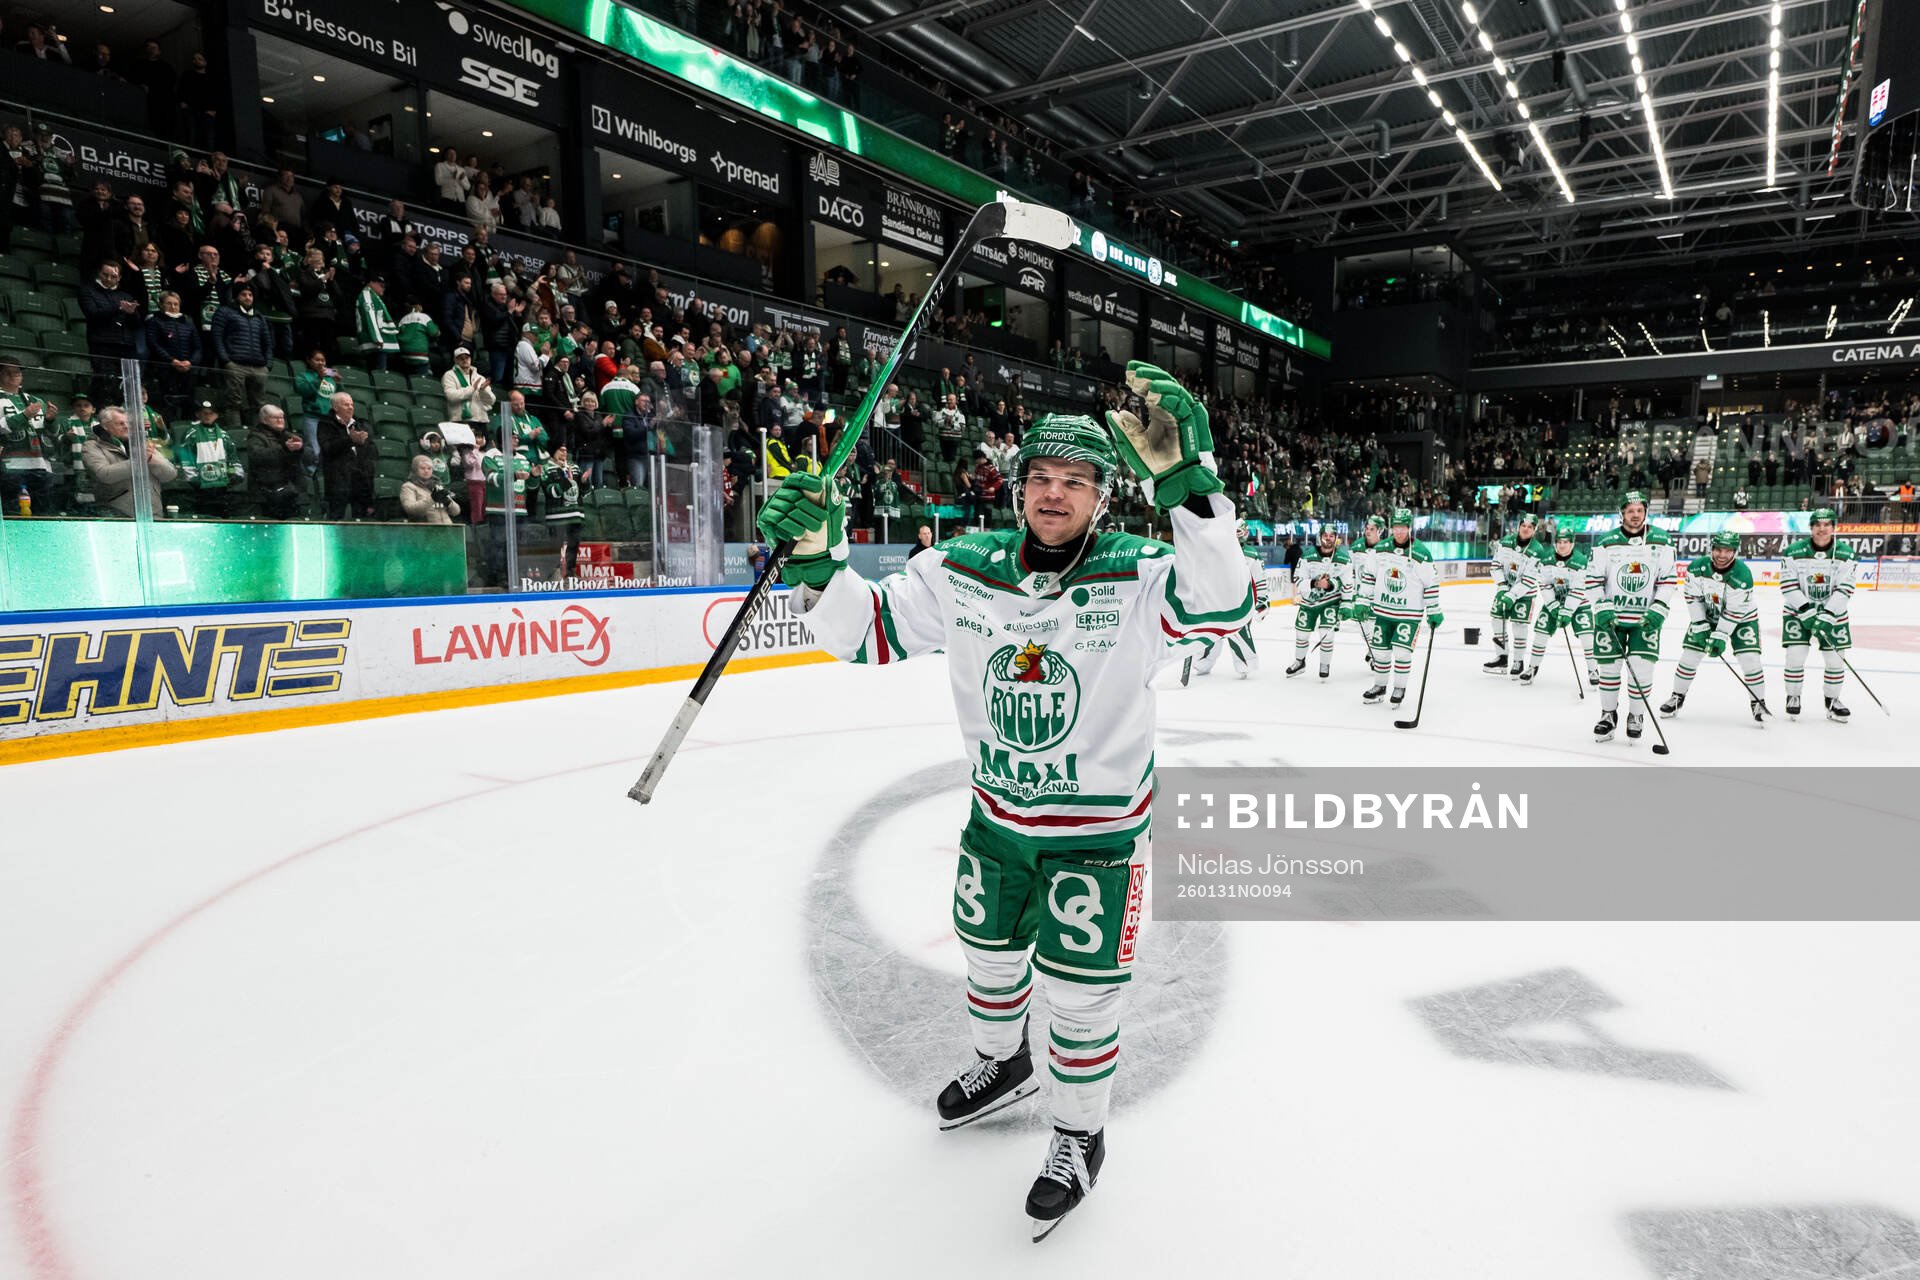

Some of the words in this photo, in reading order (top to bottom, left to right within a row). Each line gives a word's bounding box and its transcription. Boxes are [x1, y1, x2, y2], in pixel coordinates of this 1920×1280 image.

[393, 40, 417, 67] Bil
[473, 24, 559, 78] swedlog
[458, 57, 542, 107] SSE
[614, 115, 697, 163] Wihlborgs
[80, 145, 167, 179] BJÄRE
[82, 162, 168, 188] ENTREPRENAD
[727, 160, 779, 194] prenad
[819, 195, 864, 227] DACO
[1832, 345, 1904, 362] CATENA
[521, 577, 565, 592] Boozt
[568, 576, 610, 591] Boozt
[614, 575, 652, 589] Boozt
[658, 574, 692, 588] Boozt
[1090, 585, 1115, 597] Solid
[1380, 592, 1408, 606] MAXI
[1613, 595, 1648, 607] MAXI
[956, 616, 983, 634] akea
[1078, 613, 1116, 625] ER-HO
[1086, 623, 1107, 632] BYGG
[991, 686, 1066, 746] RÖGLE
[979, 739, 1078, 789] MAXI
